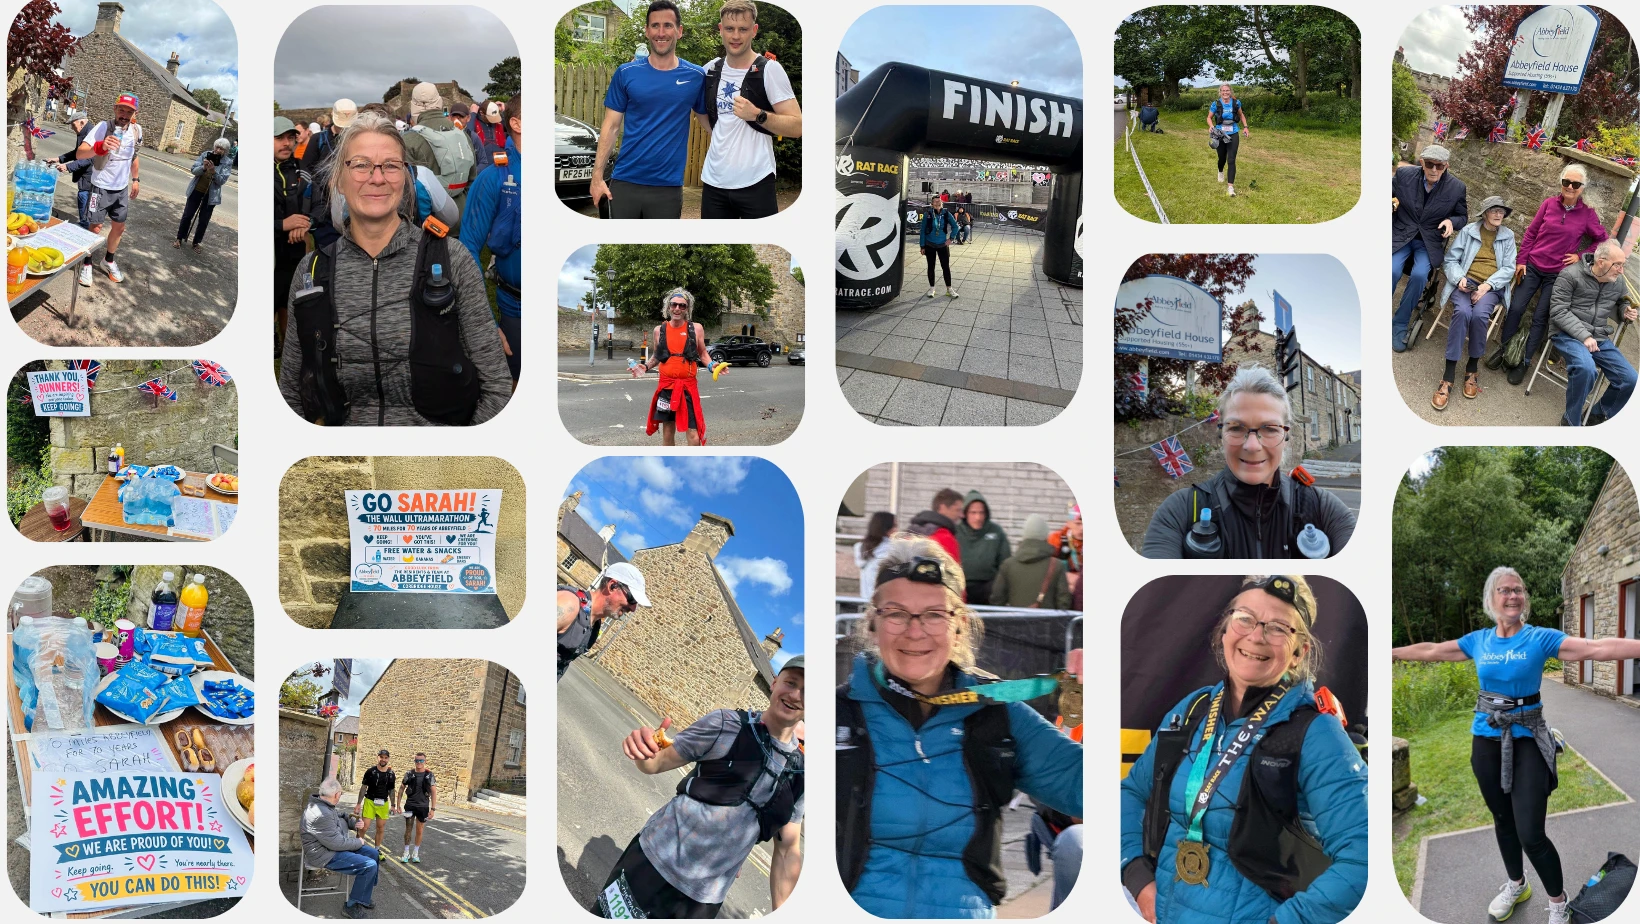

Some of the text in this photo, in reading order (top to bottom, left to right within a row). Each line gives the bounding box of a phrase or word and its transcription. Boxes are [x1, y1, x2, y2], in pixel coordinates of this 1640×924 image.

[1536, 25, 1570, 39] Abbeyfield
[1510, 60, 1578, 72] Abbeyfield House
[943, 80, 1074, 138] FINISH
[562, 170, 582, 178] RF25
[856, 161, 898, 174] RAT RACE
[1152, 296, 1192, 310] Abbeyfield
[1119, 336, 1151, 344] Supported
[1152, 339, 1174, 347] Housing
[1128, 326, 1215, 344] bbeyfield House
[1118, 345, 1170, 355] ww.abbeyfield.com
[34, 372, 80, 383] THANK YOU,
[38, 382, 80, 393] RUNNERS!
[362, 492, 476, 512] GO SARAH!
[1481, 650, 1527, 664] Abbeyfield
[1218, 731, 1250, 766] THE
[1250, 682, 1290, 722] WALL
[66, 748, 83, 758] FOR
[96, 753, 151, 773] SARAH
[72, 776, 196, 805] AMAZING
[73, 800, 204, 838] EFFORT!
[83, 836, 212, 856] WE ARE PROUD OF YOU!
[67, 864, 114, 877] Keep going.
[175, 859, 194, 867] You're
[196, 860, 215, 869] nearly
[90, 876, 220, 898] YOU CAN DO THIS!
